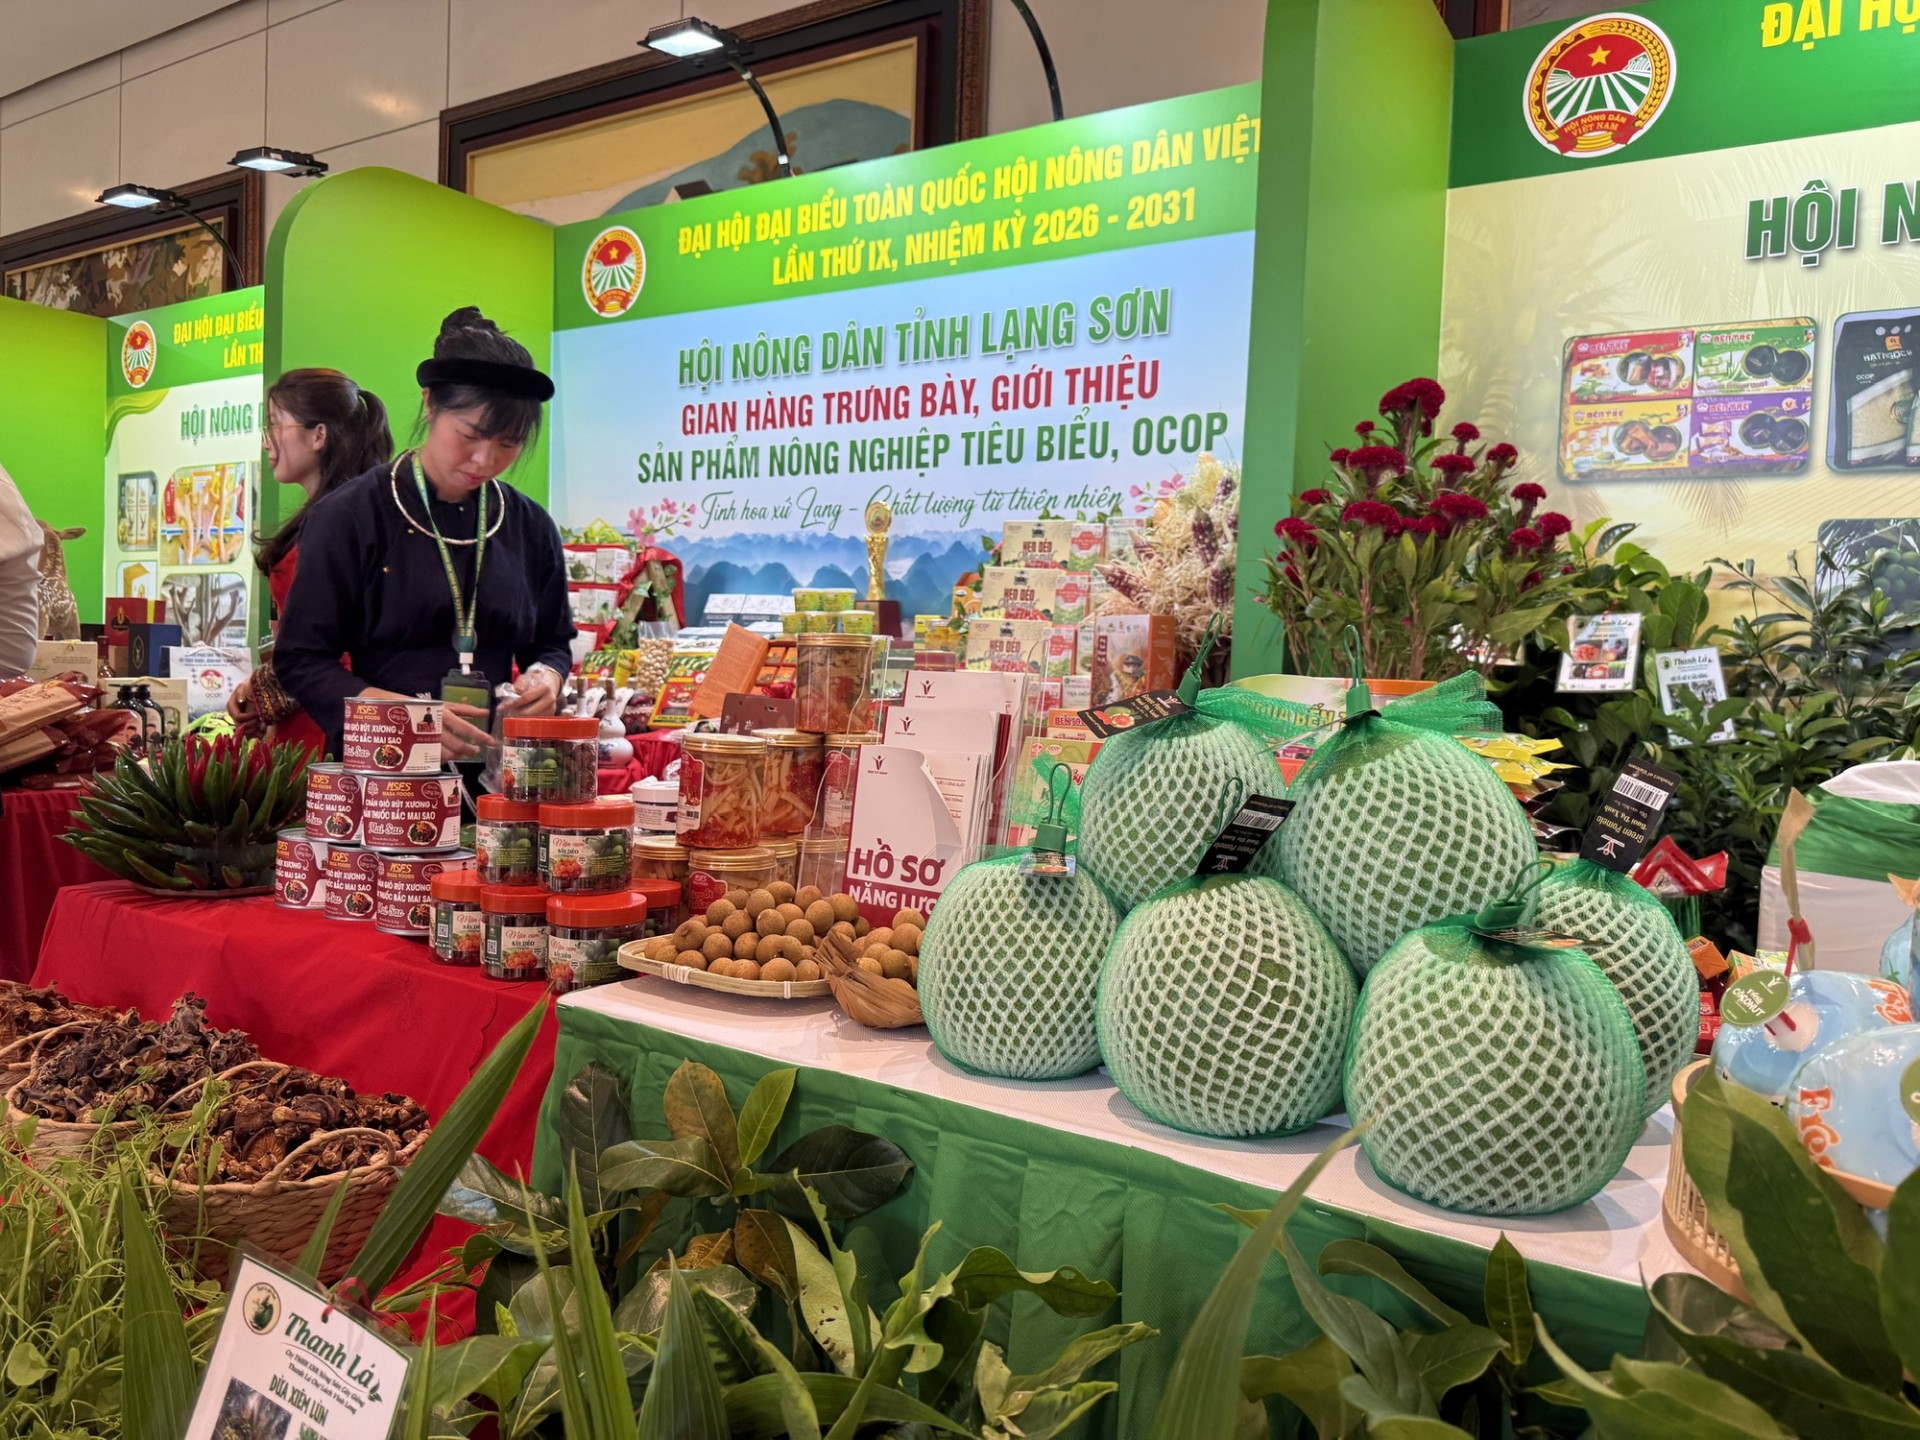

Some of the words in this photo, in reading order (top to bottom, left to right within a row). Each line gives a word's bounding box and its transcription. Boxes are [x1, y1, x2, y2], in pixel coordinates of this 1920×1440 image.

[1761, 0, 1843, 50] ĐẠI
[1581, 113, 1607, 124] NÔNG
[1596, 122, 1619, 131] NAM
[679, 224, 711, 258] ĐẠI
[717, 211, 750, 251] HỘI
[756, 207, 791, 244] ĐẠI
[797, 188, 847, 234] BIỂU
[853, 183, 913, 224] TOÀN
[920, 162, 986, 215] QUỐC
[994, 156, 1037, 203] HỘI
[1045, 145, 1123, 190] NÔNG
[1131, 129, 1193, 175] DÂN
[773, 244, 814, 285] LẦN
[820, 238, 865, 278] THỨ
[868, 239, 898, 271] IX,
[905, 221, 985, 265] NHIỆM
[993, 209, 1026, 252] KỲ
[1032, 203, 1100, 245] 2026
[1126, 187, 1195, 231] 2031
[1745, 178, 1858, 267] HỘI
[173, 321, 192, 347] ĐẠI
[194, 314, 213, 344] HỘI
[215, 313, 234, 339] ĐẠI
[237, 300, 264, 332] BIỂU
[678, 338, 722, 392] HỘI
[732, 332, 811, 381] NÔNG
[821, 321, 884, 373] DÂN
[896, 304, 969, 364] TỈNH
[981, 301, 1074, 362] LẠNG
[1088, 287, 1170, 341] SƠN
[223, 338, 246, 369] LẦN
[248, 341, 263, 364] TH
[682, 401, 737, 436] GIAN
[746, 391, 813, 431] HÀNG
[823, 385, 910, 425] TRƯNG
[921, 372, 979, 418] BÀY,
[992, 364, 1052, 412] GIỚI
[1065, 354, 1159, 410] THIỆU
[181, 404, 205, 446] HỘI
[210, 400, 252, 436] NÔNG
[638, 441, 682, 483] SẢN
[692, 435, 759, 481] PHẨM
[769, 437, 839, 477] NÔNG
[849, 427, 950, 478] NGHIỆP
[961, 421, 1024, 466] TIÊU
[1036, 407, 1118, 463] BIỂU,
[1132, 412, 1228, 456] OCOP
[699, 490, 738, 529] Tinh
[741, 501, 769, 521] hoa
[796, 487, 843, 530] Lạng
[1005, 487, 1057, 511] thiên
[1064, 484, 1122, 510] nhiên
[371, 725, 396, 734] XƯƠNG
[323, 793, 346, 802] XƯƠNG
[325, 804, 337, 812] MAI
[337, 804, 352, 812] SAO
[392, 799, 403, 808] RÚT
[405, 800, 430, 808] XƯƠNG
[391, 809, 405, 820] BẮC
[407, 812, 420, 820] MAI
[422, 812, 436, 820] SAO
[1596, 815, 1620, 834] Pomelo
[1621, 827, 1645, 844] Green
[852, 838, 894, 879] HỒ
[900, 855, 946, 886] SƠ
[295, 872, 307, 880] SAO
[343, 872, 366, 881] XƯƠNG
[345, 883, 357, 891] MAI
[357, 883, 372, 891] SAO
[405, 883, 431, 892] XƯƠNG
[408, 895, 421, 903] MAI
[422, 895, 431, 903] SA
[849, 882, 897, 908] NĂNG
[1732, 988, 1766, 1017] COCONUT
[285, 1312, 347, 1369] Thanh
[347, 1354, 376, 1388] Lá
[269, 1374, 289, 1400] DỪA
[288, 1386, 311, 1414] XIÊM
[309, 1399, 329, 1427] LÙN
